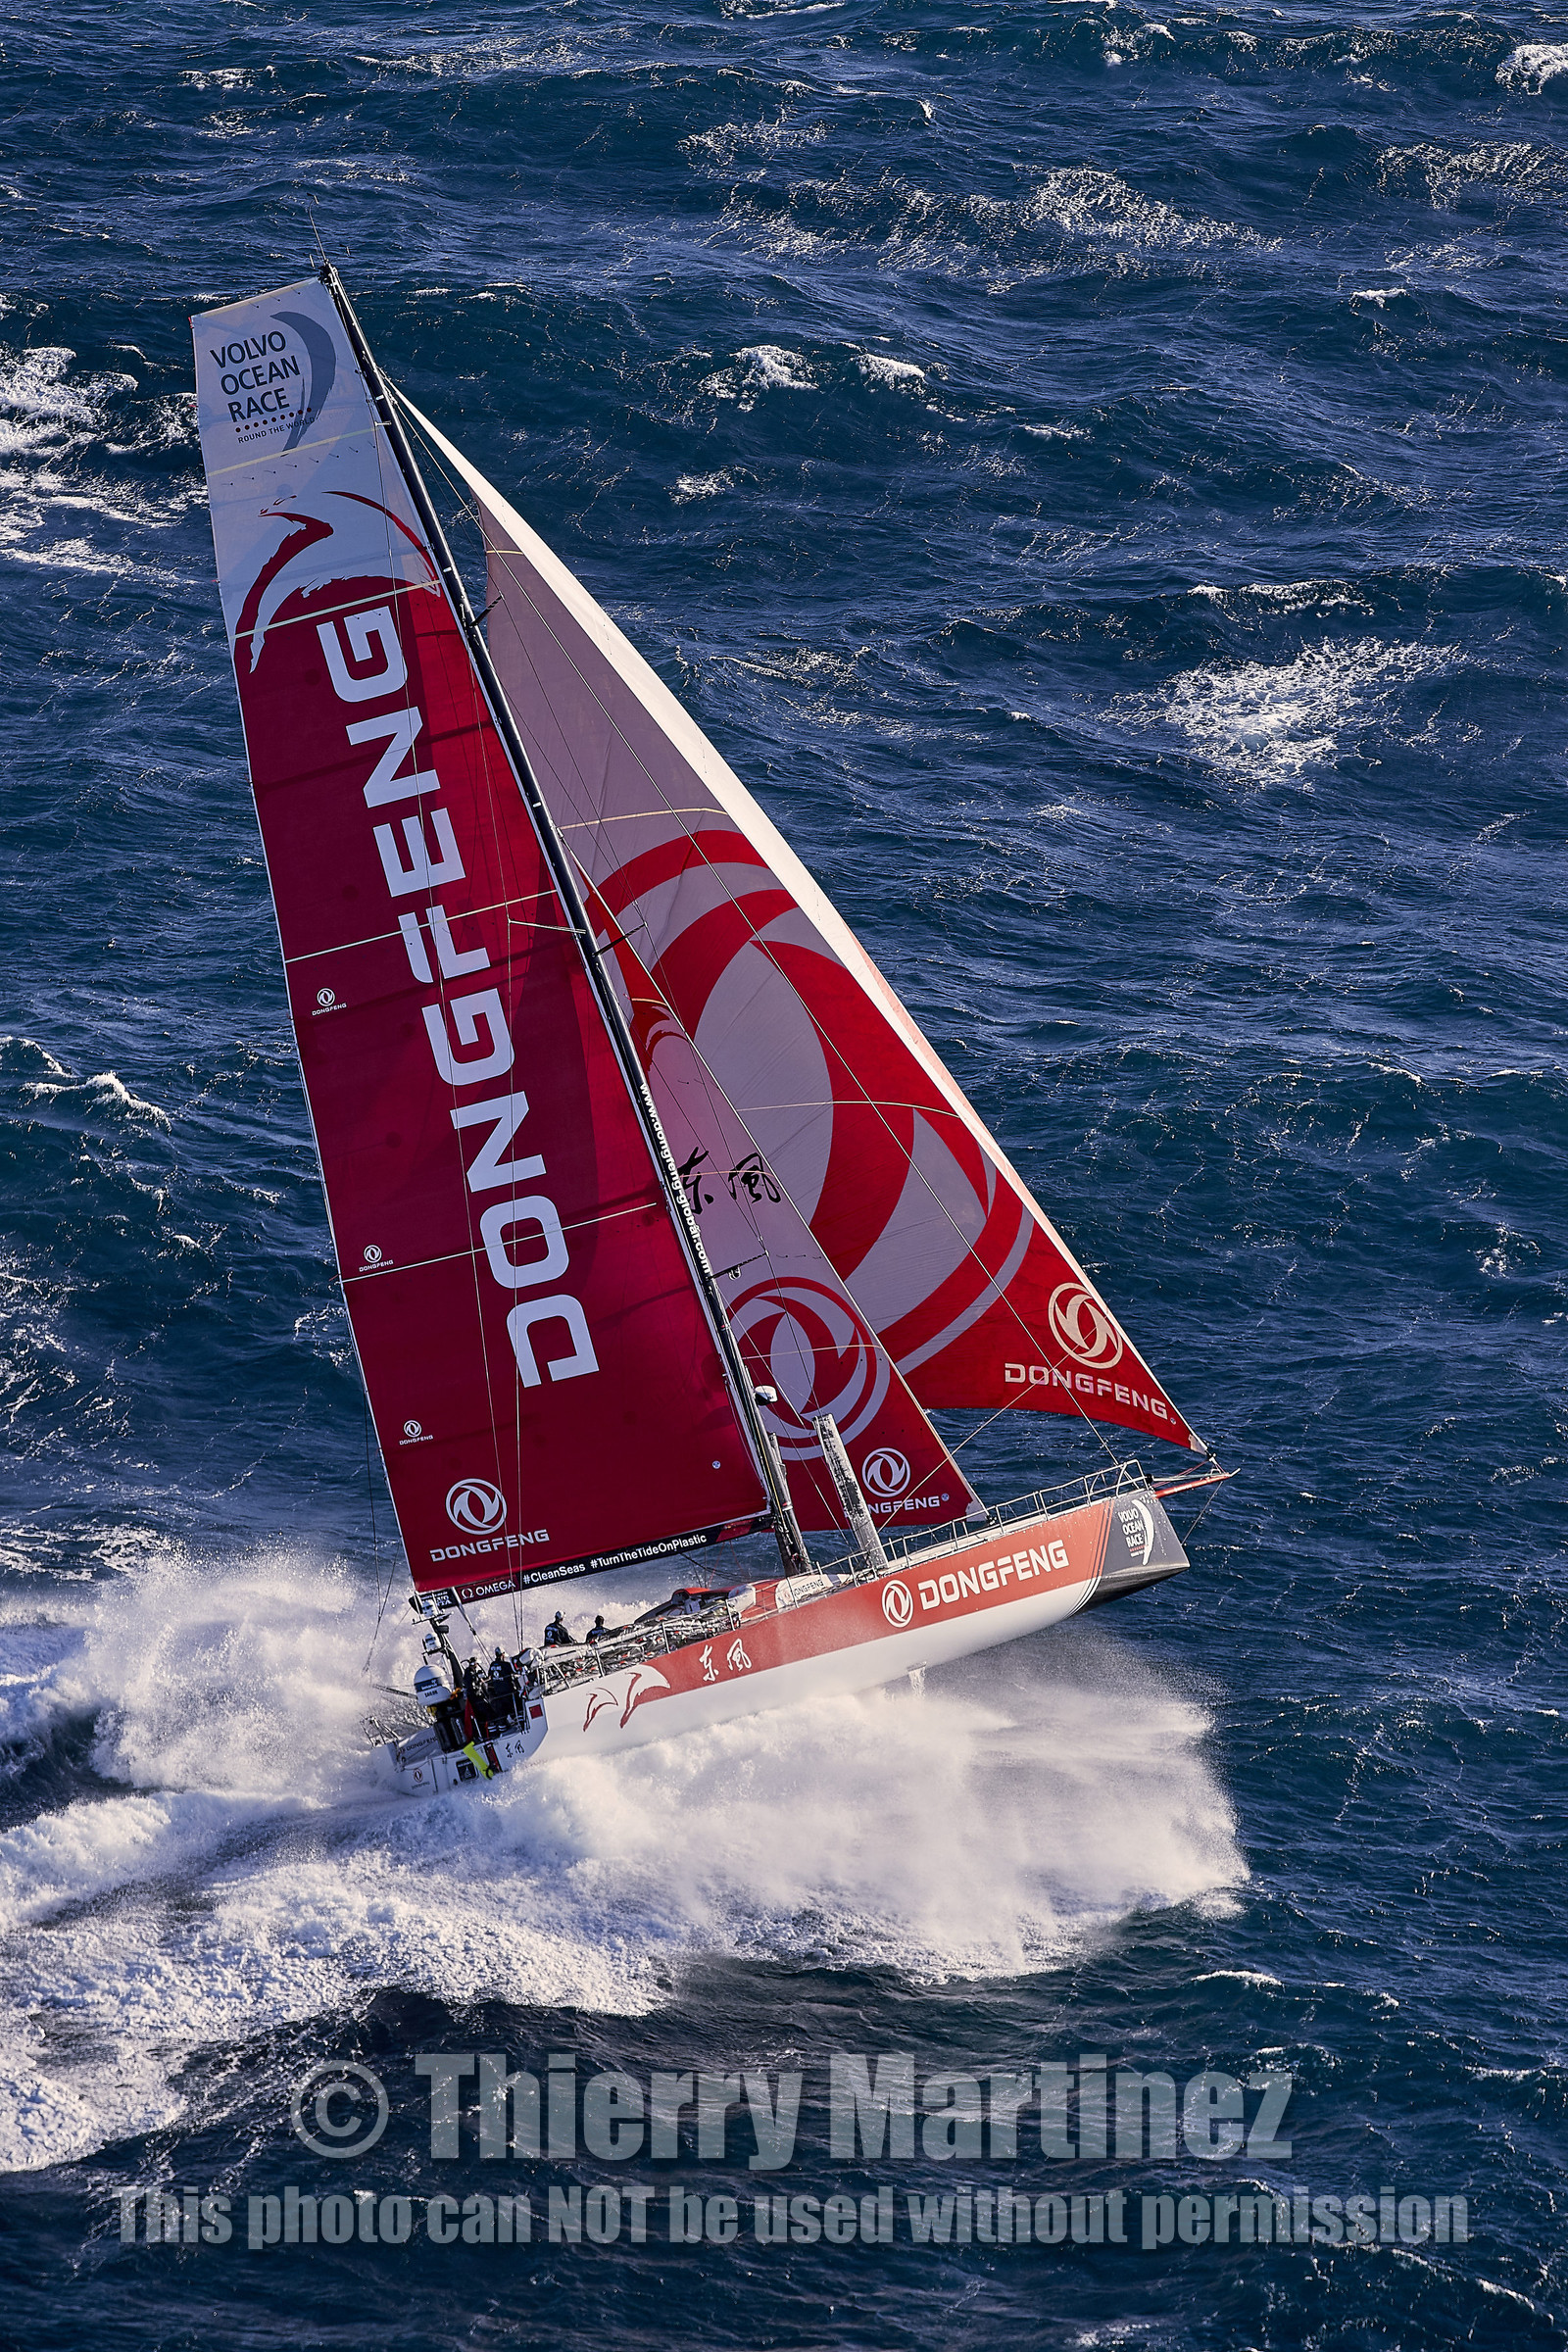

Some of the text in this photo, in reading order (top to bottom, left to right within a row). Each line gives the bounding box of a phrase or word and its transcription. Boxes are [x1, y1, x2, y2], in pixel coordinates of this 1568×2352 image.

[210, 331, 286, 368] VOLVO
[220, 355, 301, 395] OCEAN
[227, 387, 290, 422] RACE
[237, 416, 316, 444] ROUND THE WORLD
[311, 1003, 348, 1016] DONGFENG
[316, 605, 600, 1389] DONGFENG
[639, 1082, 711, 1274] www.dongfeng-global.com
[358, 1259, 395, 1273] DONGFENG
[1004, 1362, 1168, 1420] DONGFENG
[843, 1495, 941, 1518] NGFENG
[1117, 1507, 1139, 1523] VOLVO
[429, 1528, 550, 1562] DONGFENG
[1122, 1520, 1145, 1536] OCEAN
[1125, 1534, 1145, 1548] RACE
[522, 1533, 708, 1585] #CleanSeas #TurnTheTideOnPlastic
[918, 1539, 1070, 1611] DONGFENG
[475, 1579, 516, 1596] OMEGA
